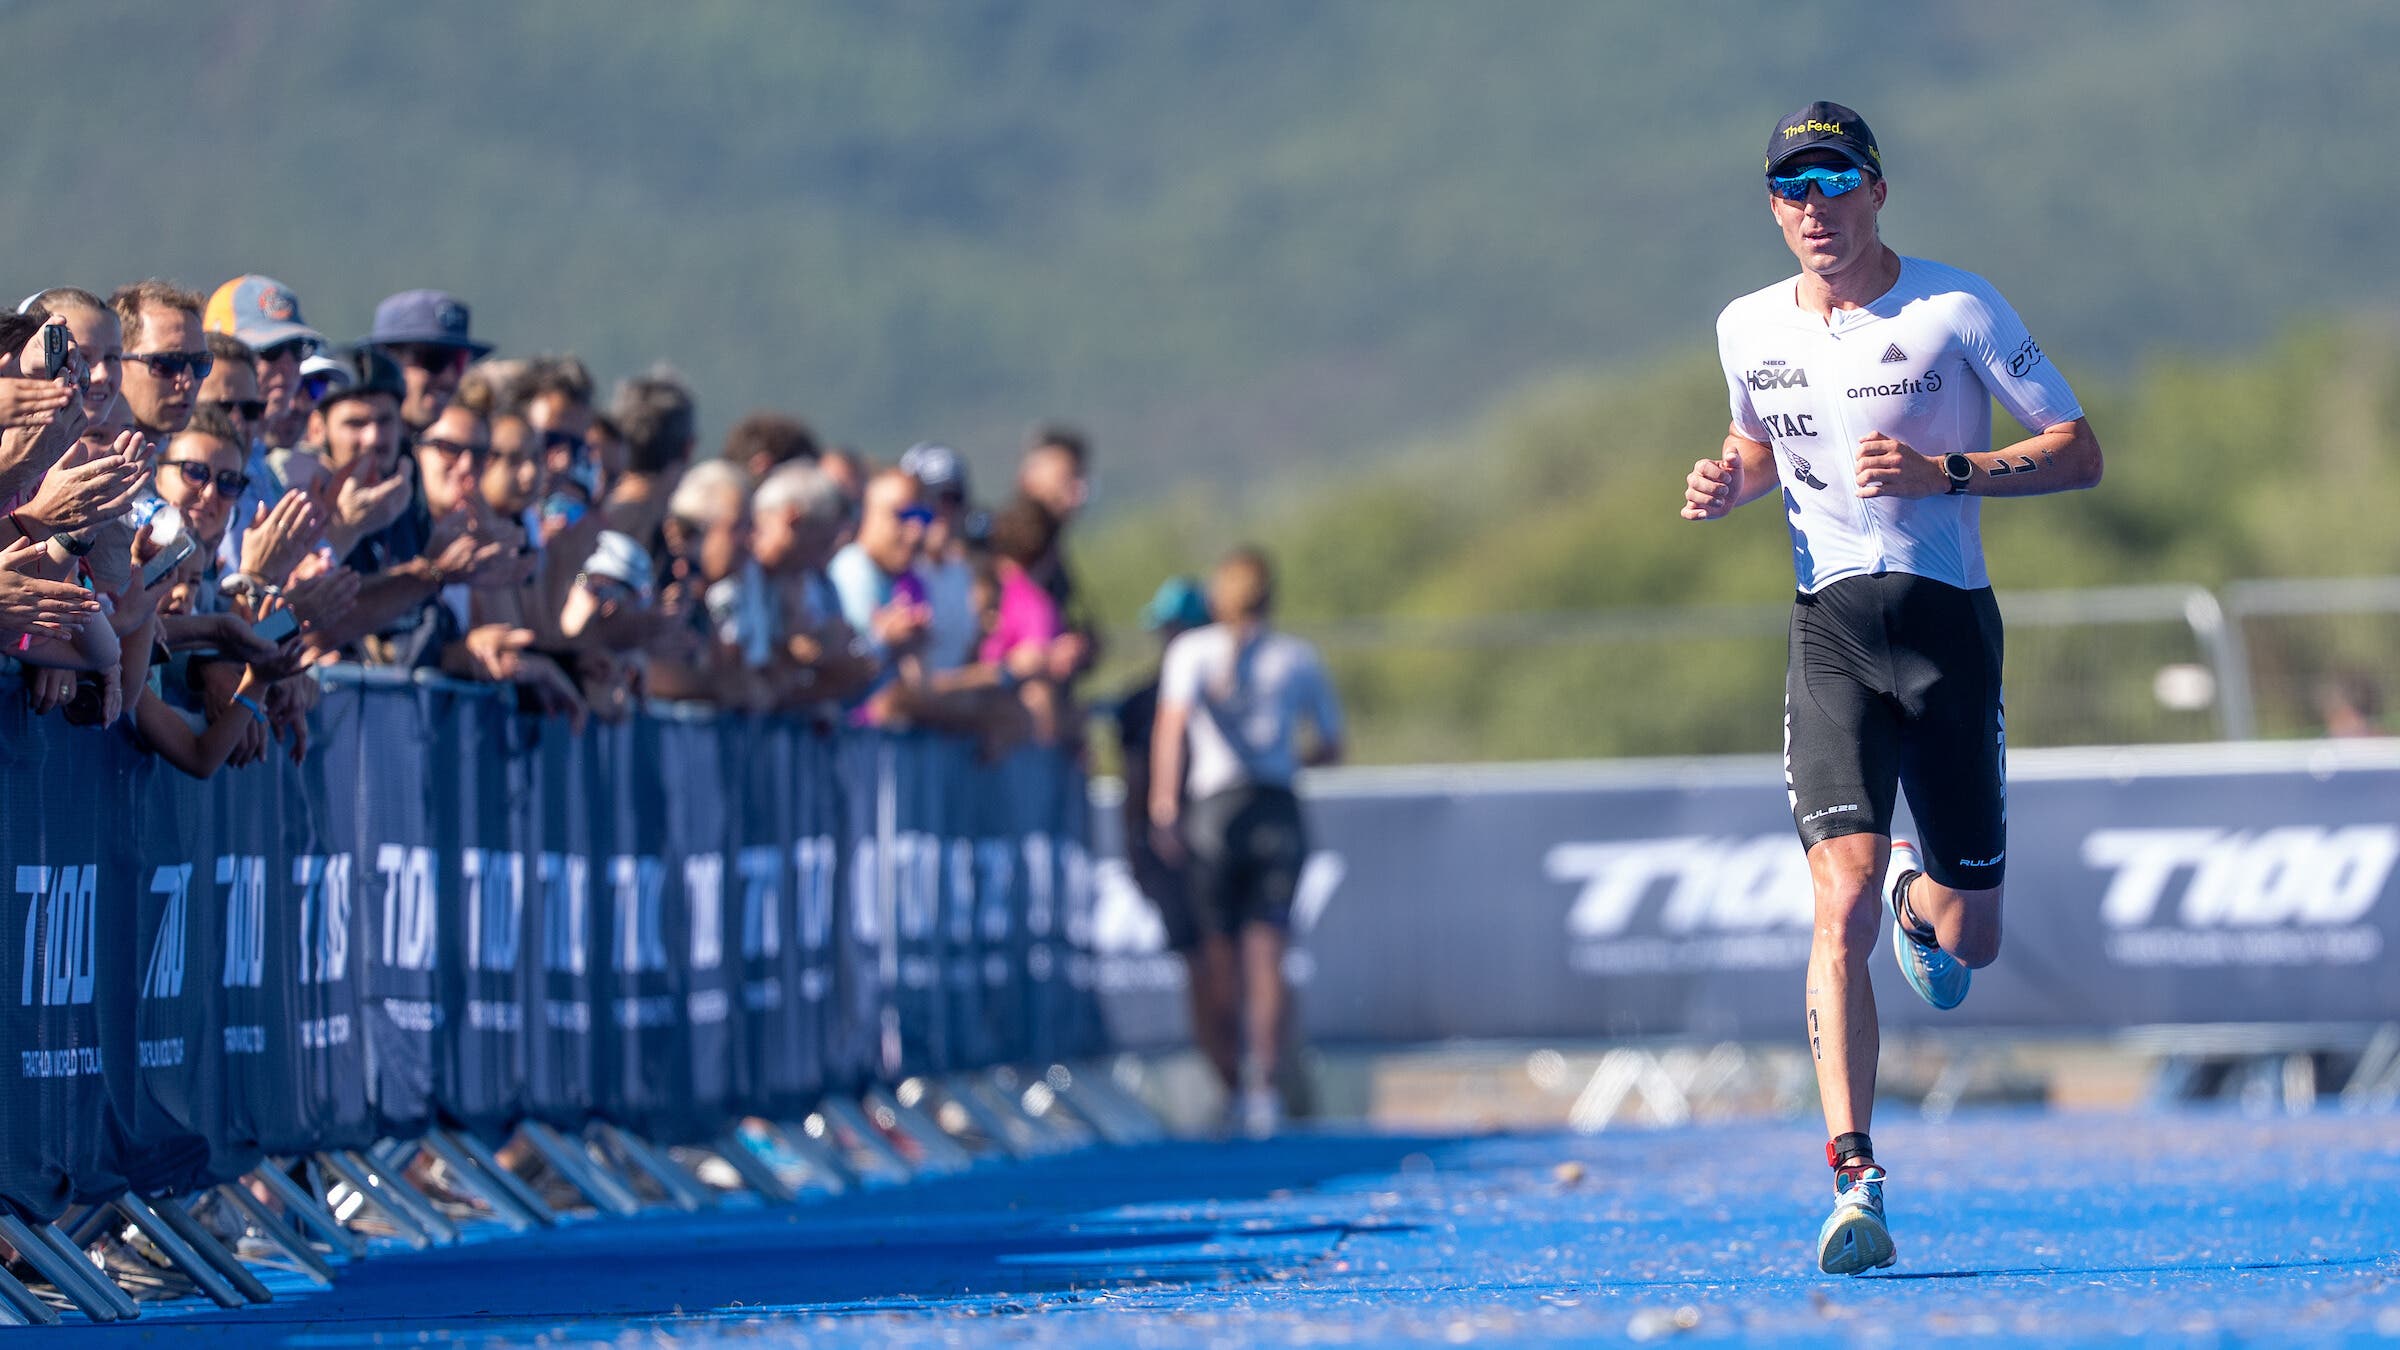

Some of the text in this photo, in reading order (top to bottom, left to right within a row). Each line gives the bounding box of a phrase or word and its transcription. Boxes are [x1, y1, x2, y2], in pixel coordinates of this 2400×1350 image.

[1783, 124, 1806, 140] The
[1746, 368, 1808, 391] HOKA
[1847, 378, 1923, 399] amazfit
[2079, 823, 2400, 931] T100
[15, 864, 97, 1006] T100
